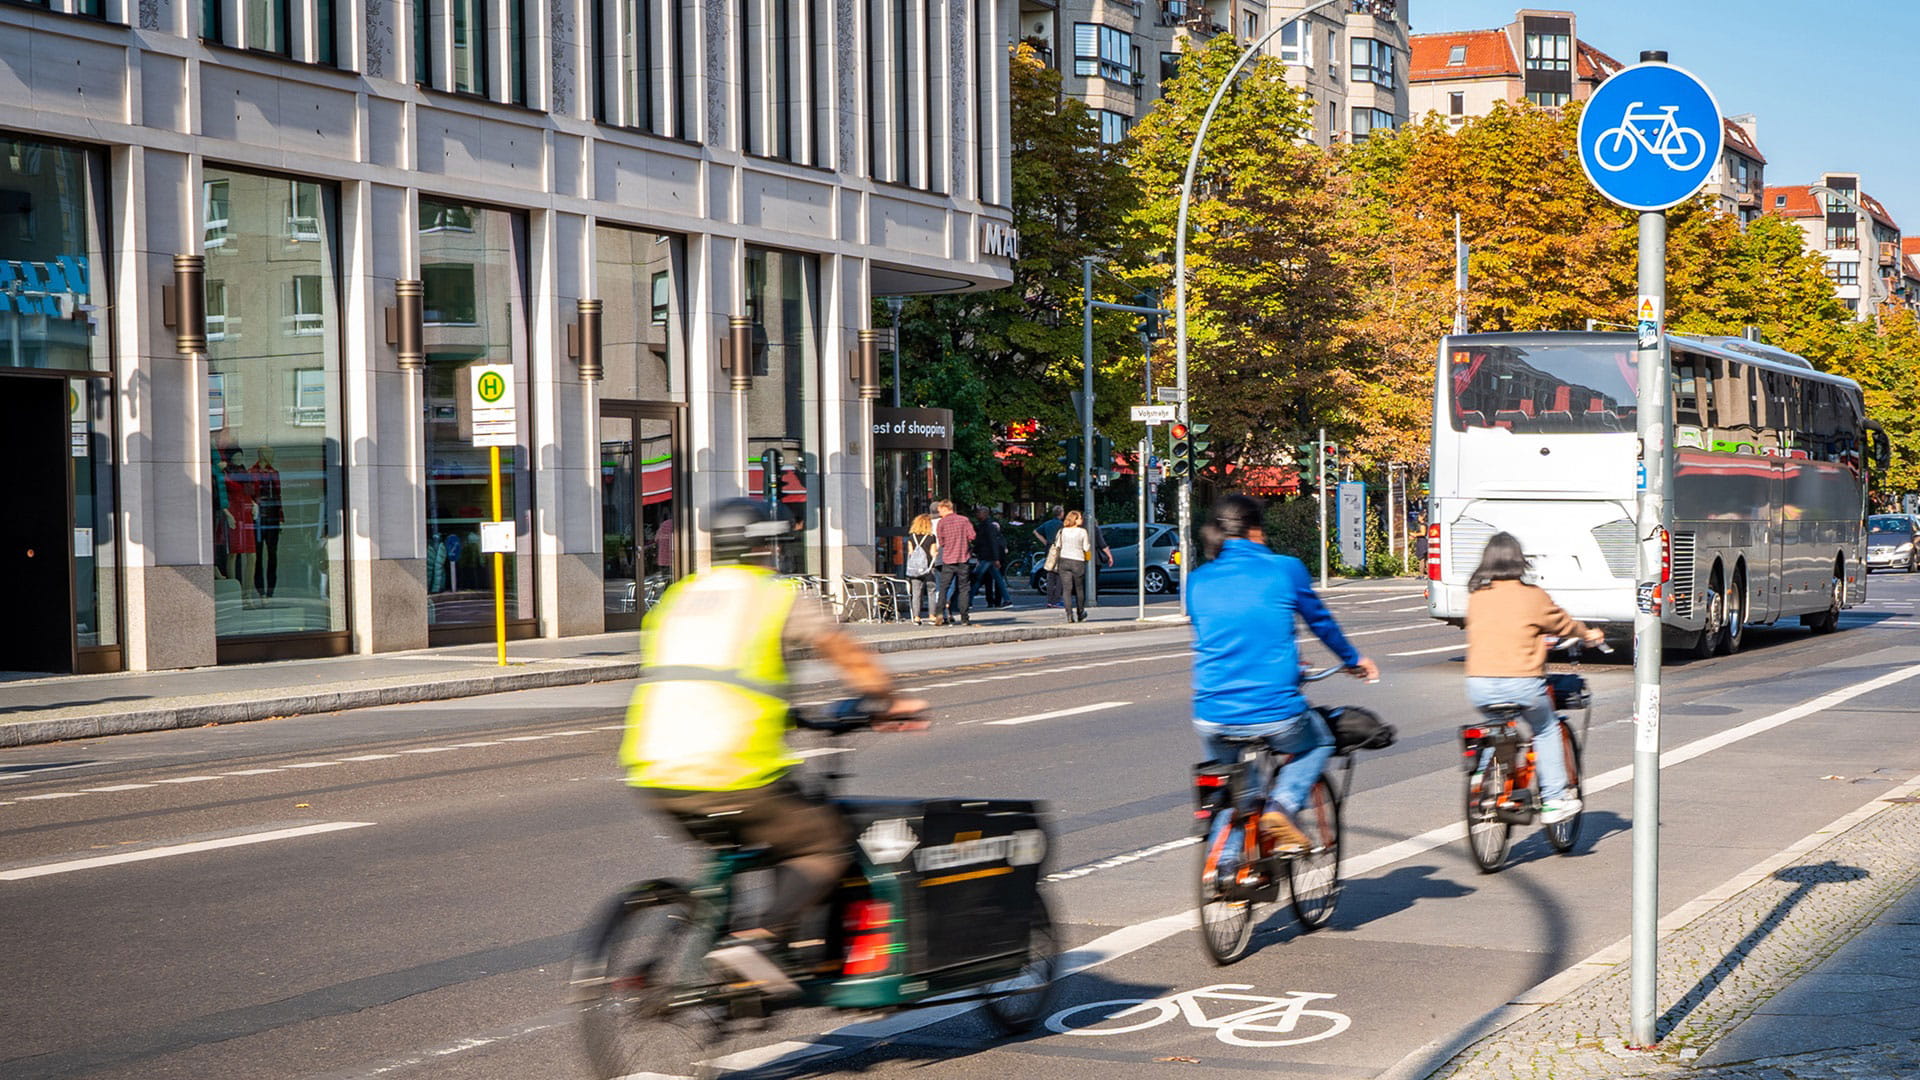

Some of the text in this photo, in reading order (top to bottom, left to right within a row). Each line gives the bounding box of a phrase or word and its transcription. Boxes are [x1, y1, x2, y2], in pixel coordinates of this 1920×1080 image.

[484, 378, 497, 396] H
[873, 420, 946, 438] est of shopping
